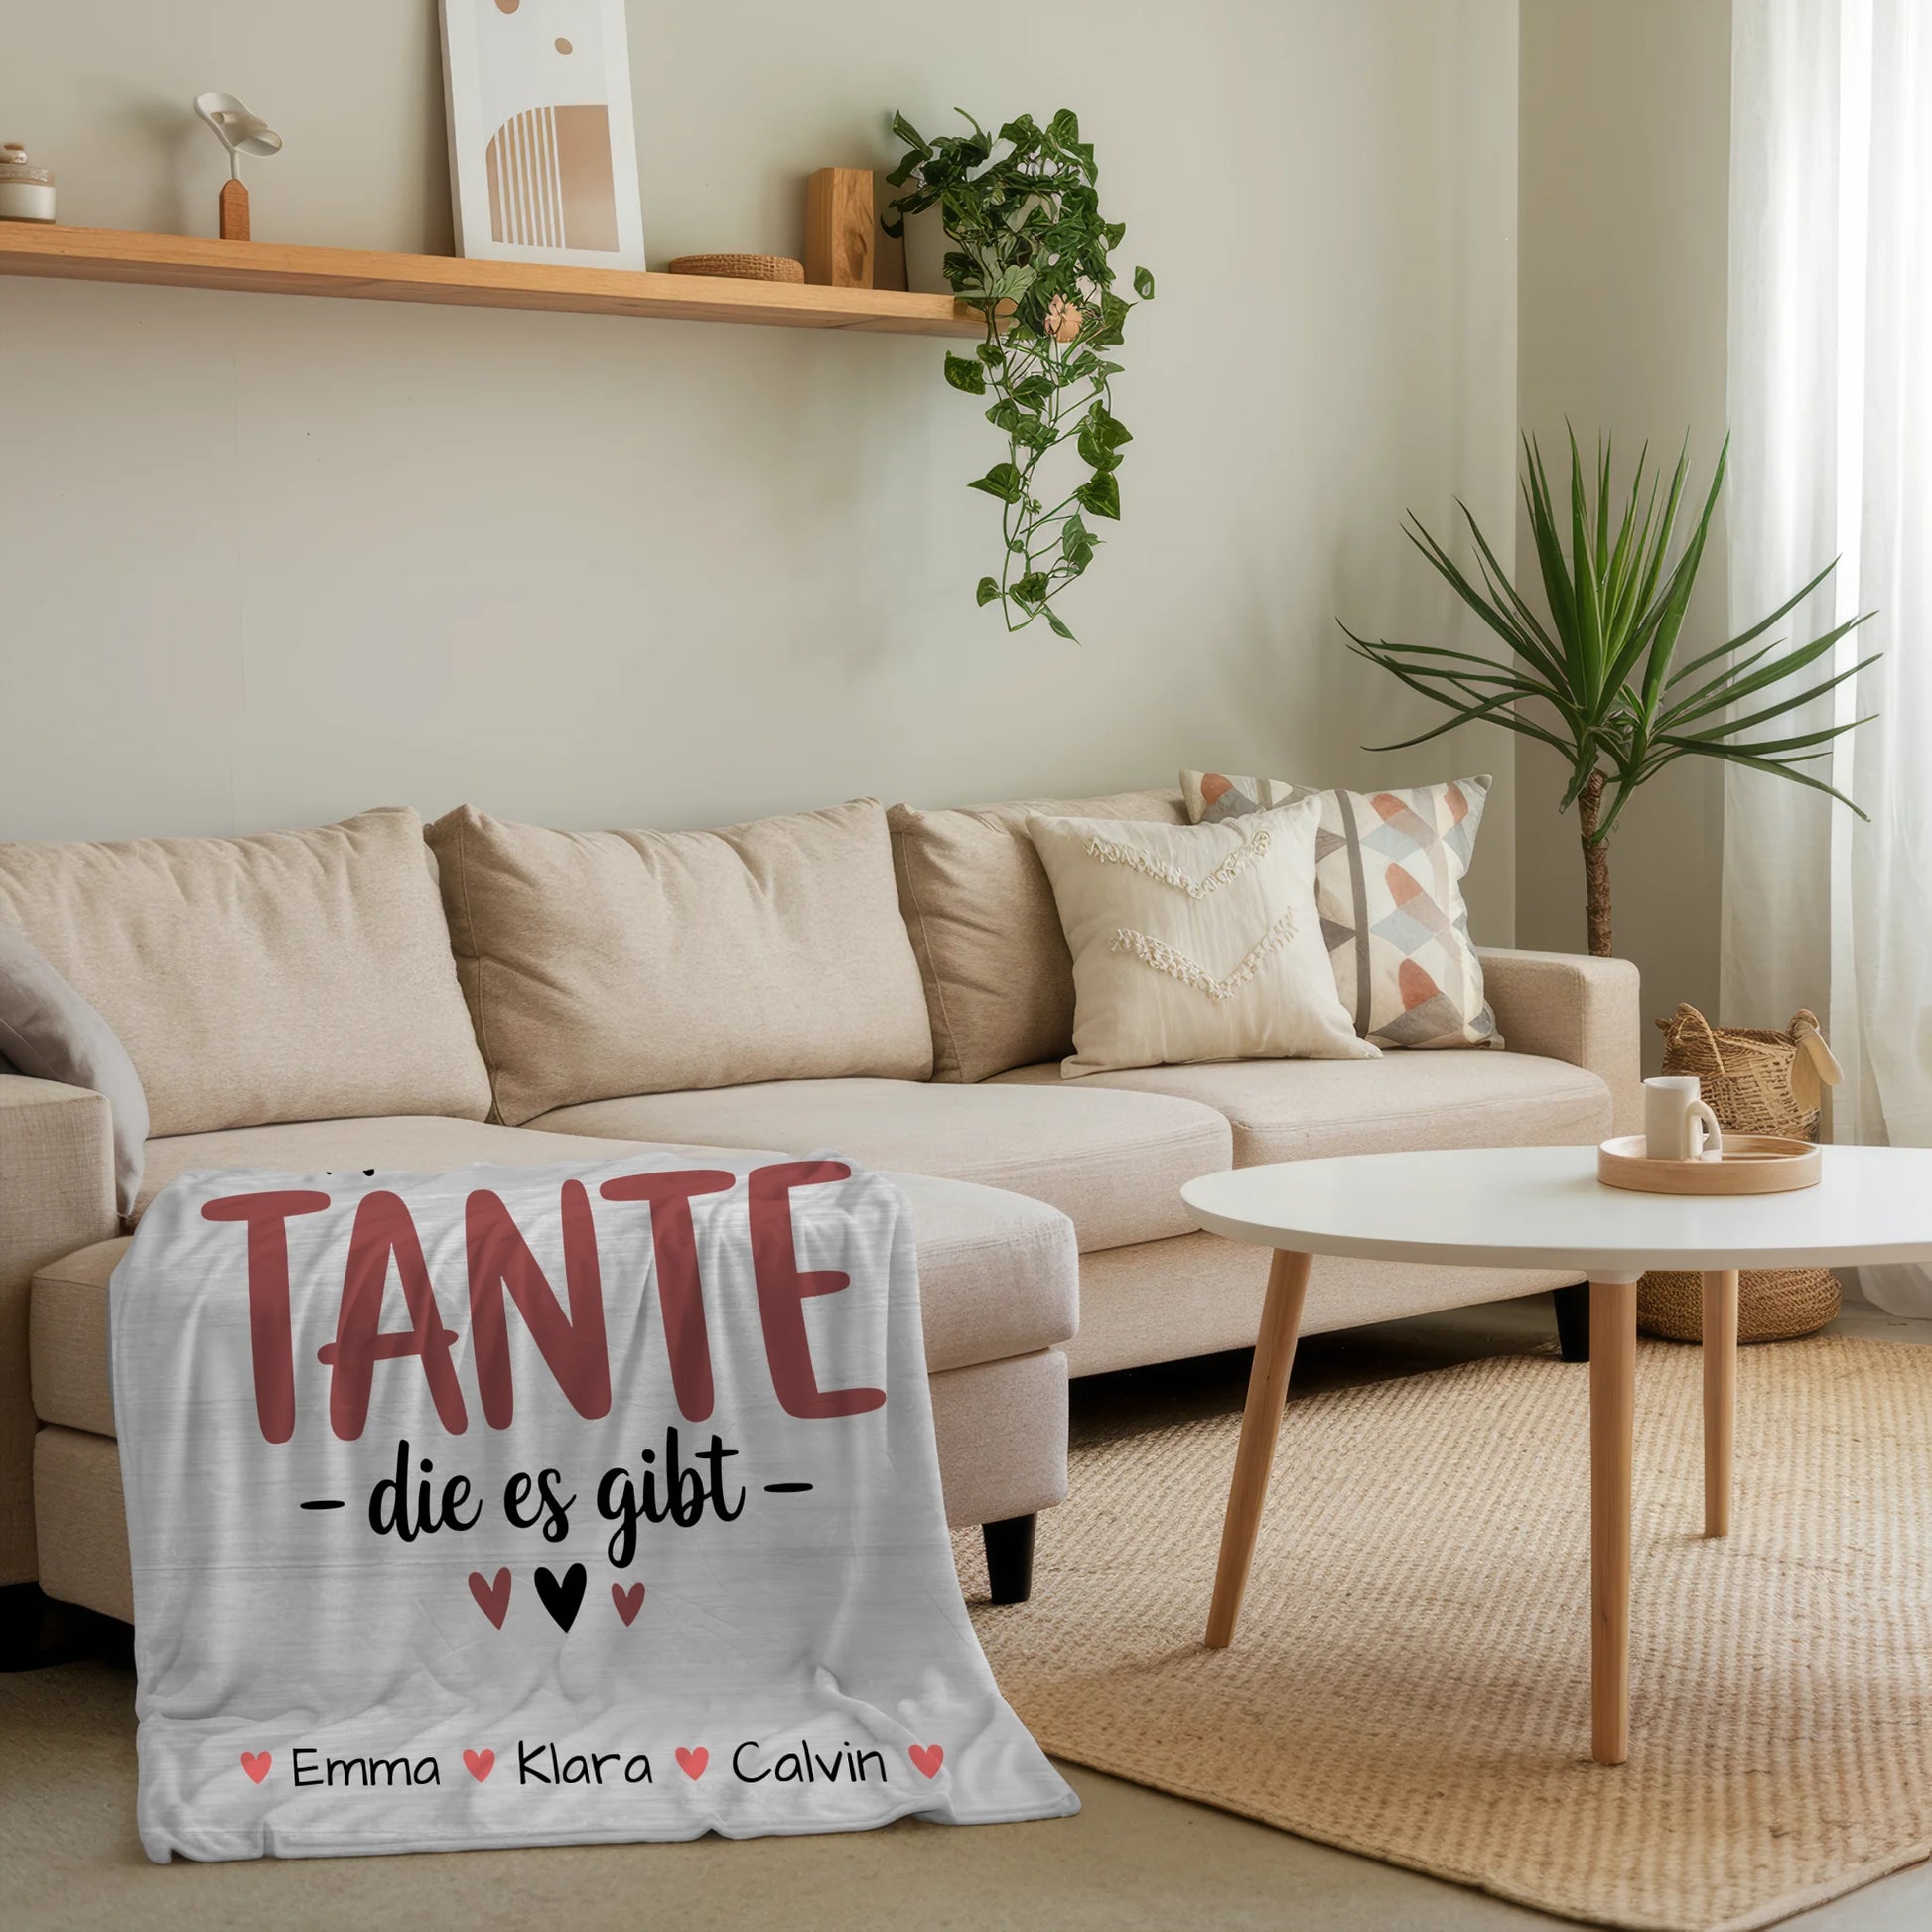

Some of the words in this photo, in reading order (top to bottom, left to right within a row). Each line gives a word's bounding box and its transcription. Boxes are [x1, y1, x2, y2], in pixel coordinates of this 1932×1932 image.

[201, 1160, 887, 1445] TANTE
[368, 1439, 483, 1543] die
[502, 1468, 577, 1543] es
[596, 1425, 747, 1569] gibt
[292, 1747, 442, 1787] Emma
[517, 1739, 654, 1786] Klara
[731, 1739, 889, 1784] Calvin
